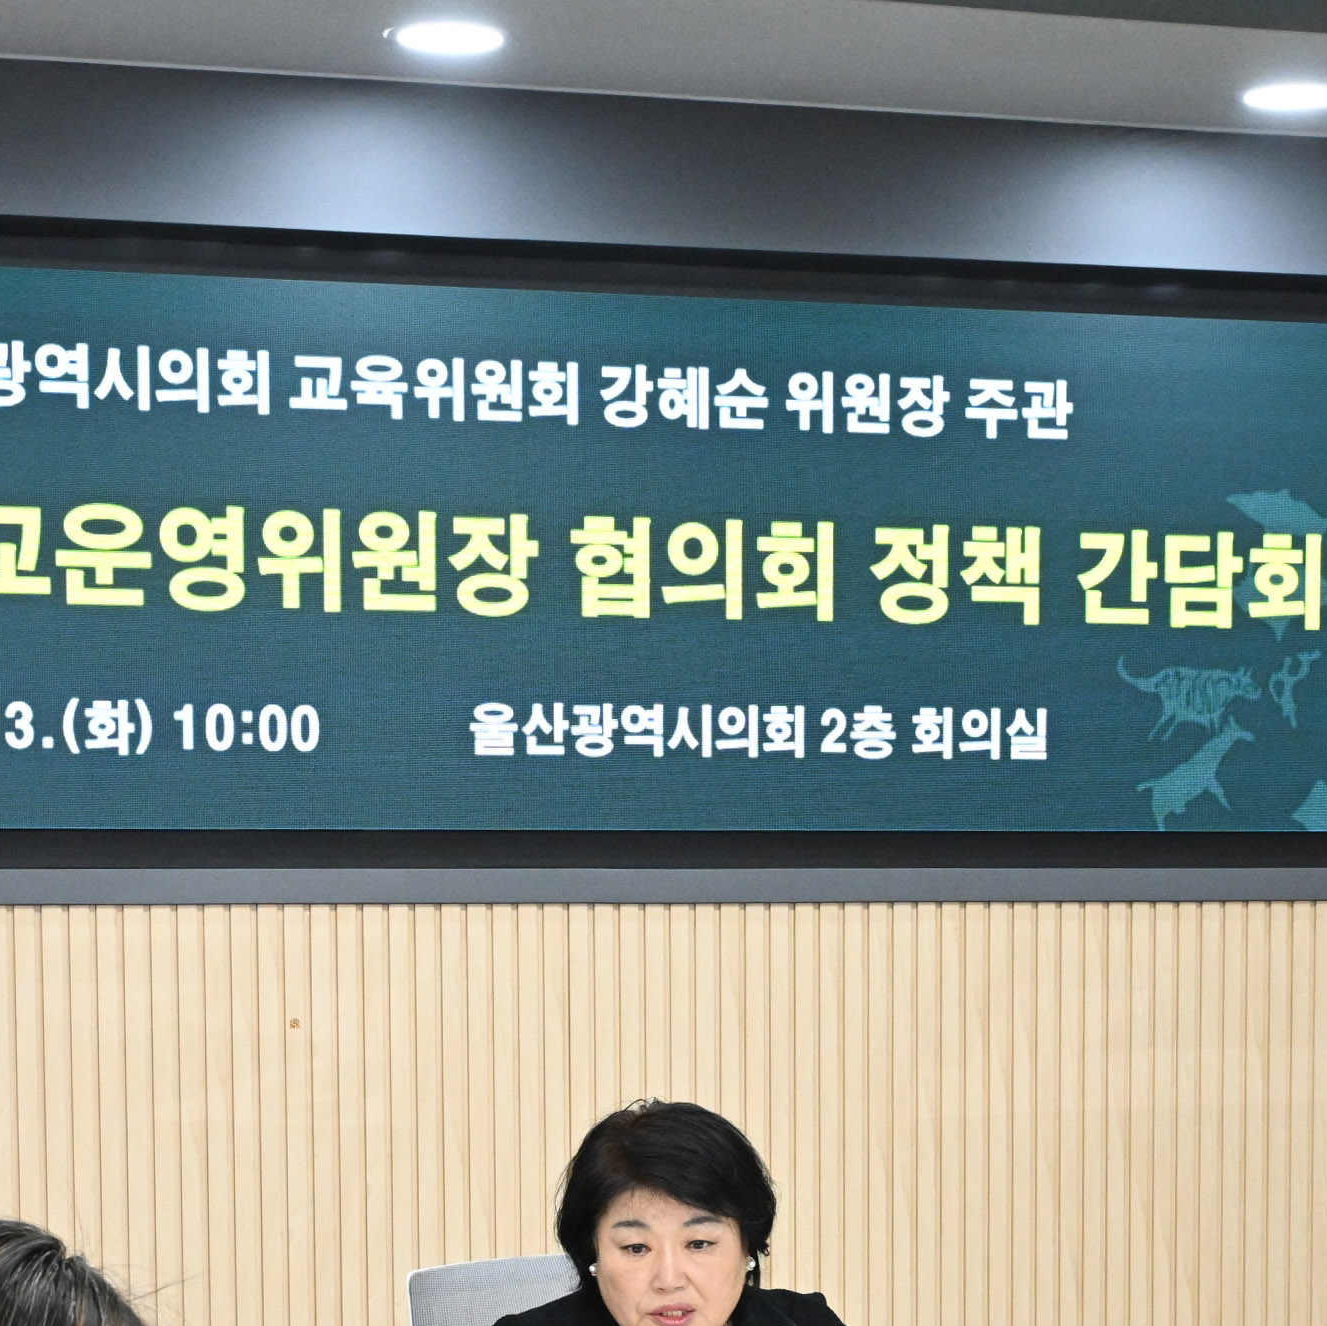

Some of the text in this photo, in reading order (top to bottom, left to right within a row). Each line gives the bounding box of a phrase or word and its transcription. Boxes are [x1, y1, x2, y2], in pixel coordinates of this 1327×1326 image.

[288, 354, 579, 426] 교육위원회
[600, 364, 769, 430] 강혜순
[785, 371, 951, 438] 위원장
[964, 378, 1074, 440] 주관
[570, 515, 834, 622] 협의회
[870, 524, 1041, 626] 정책
[1077, 529, 1323, 631] 간담회
[173, 703, 321, 752] 10:00
[469, 702, 1048, 760] 울산광역시의회 2층 회의실
